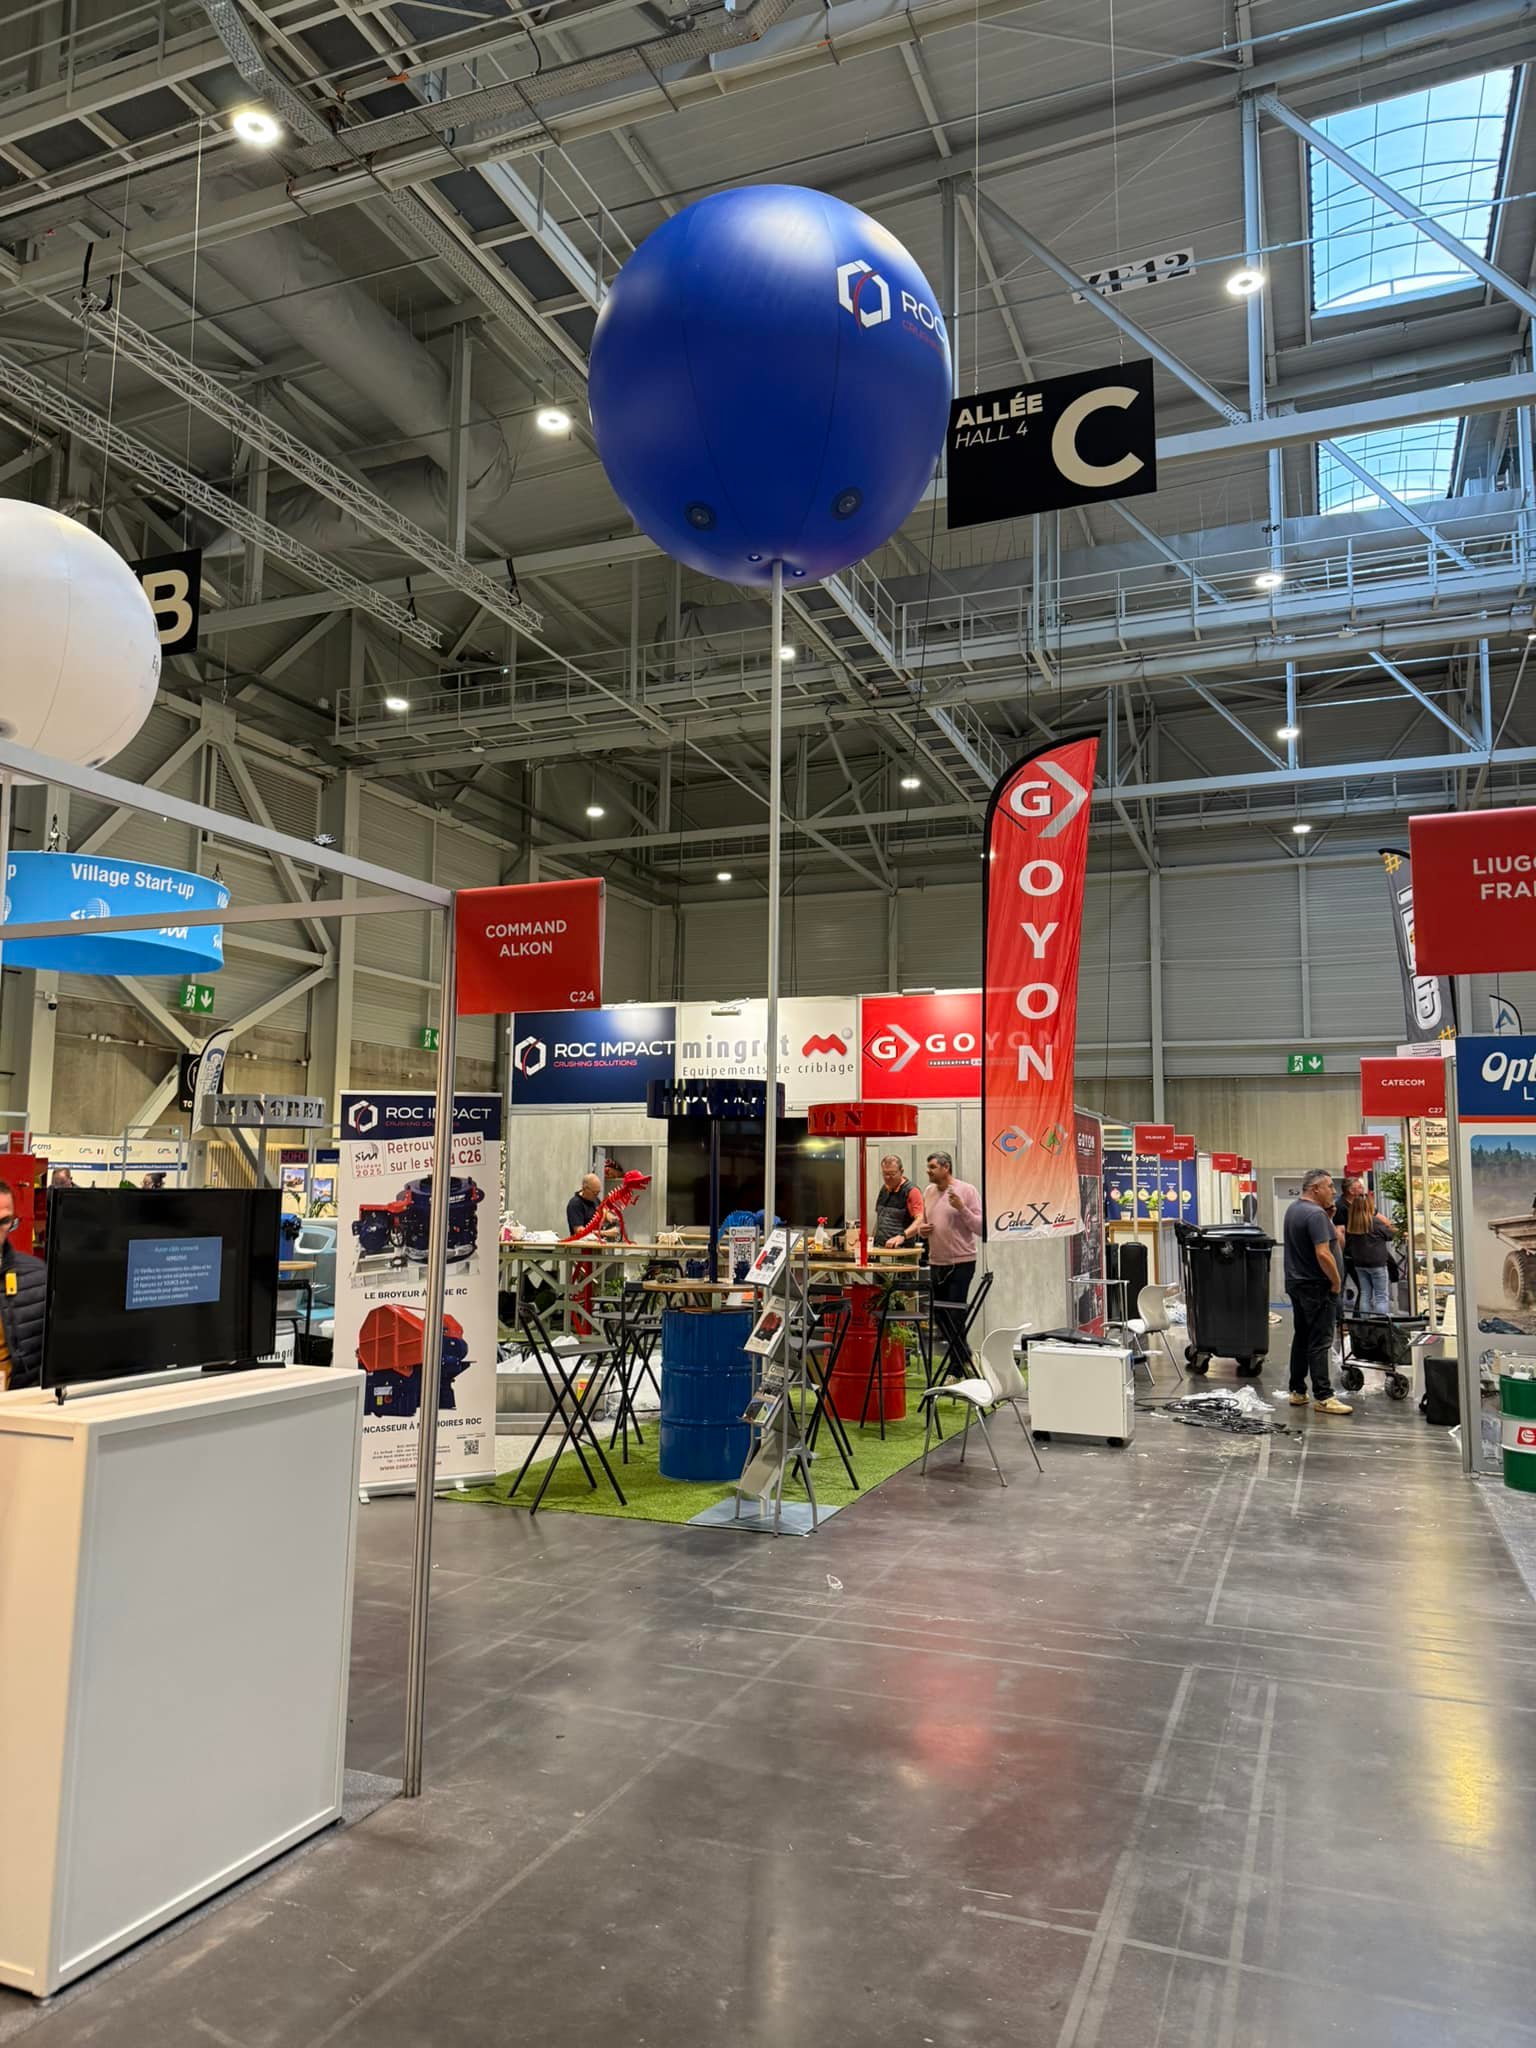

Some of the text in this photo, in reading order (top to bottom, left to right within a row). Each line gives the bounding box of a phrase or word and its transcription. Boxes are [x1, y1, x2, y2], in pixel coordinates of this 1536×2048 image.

[955, 392, 1043, 429] ALLÉE
[955, 421, 1028, 449] HALL 4
[1051, 386, 1145, 487] C
[142, 569, 193, 645] B
[1473, 855, 1536, 875] LIUG
[71, 863, 129, 887] Village
[134, 872, 194, 900] Start-up
[1481, 881, 1536, 900] FRA
[485, 920, 568, 938] COMMAND
[499, 941, 553, 957] ALKON
[569, 991, 595, 1002] C24
[554, 1041, 677, 1058] ROC IMPACT
[682, 1034, 789, 1064] mingrt
[553, 1060, 592, 1068] CRUSHING
[798, 1063, 855, 1076] criblage
[1381, 1079, 1426, 1087] CATECOM
[386, 1107, 424, 1119] ROC
[453, 1136, 482, 1147] nous
[390, 1161, 408, 1172] sur
[411, 1158, 421, 1169] le
[458, 1149, 482, 1165] C26
[356, 1169, 382, 1177] 2025
[378, 1291, 420, 1299] BROYEUR
[362, 1424, 408, 1434] NCASSEUR
